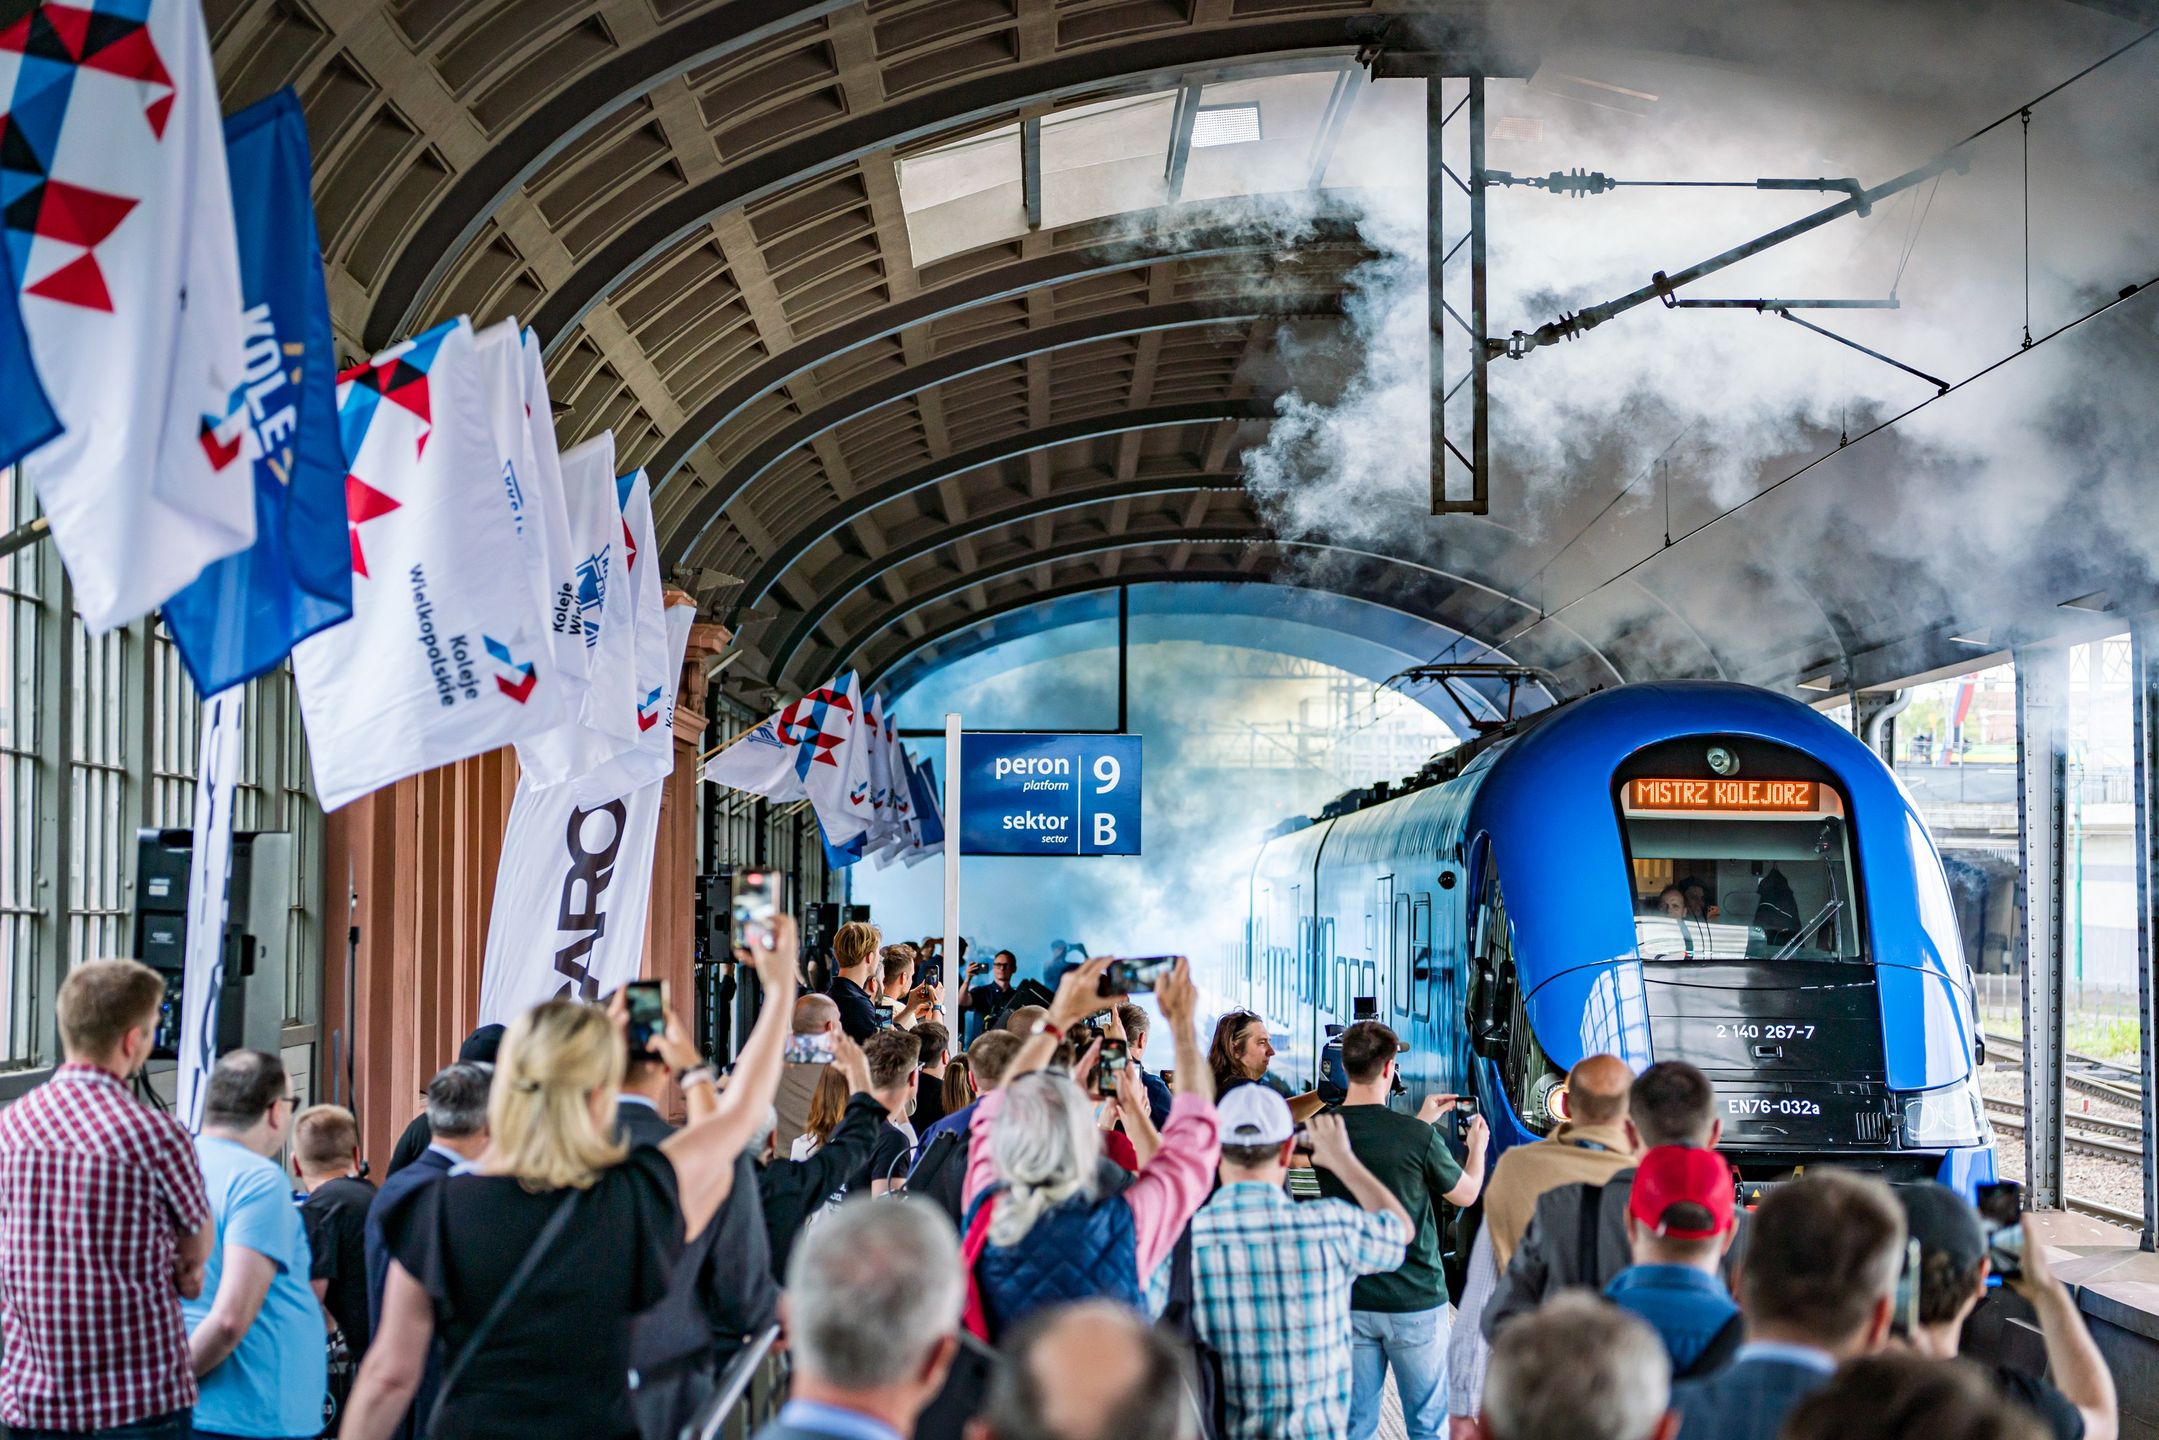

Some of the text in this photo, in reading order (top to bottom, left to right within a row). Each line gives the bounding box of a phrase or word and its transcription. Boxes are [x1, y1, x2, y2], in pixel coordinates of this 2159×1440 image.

[552, 582, 574, 633] Koleje
[408, 563, 456, 707] Wielkopolskie
[450, 634, 480, 700] Koleje
[995, 757, 1070, 780] peron
[1093, 755, 1121, 795] 9
[1022, 780, 1069, 793] platform
[1638, 781, 1809, 805] MISTRZ KOLEJORZ
[1003, 810, 1069, 830] sektor
[1093, 813, 1118, 846] B
[1041, 834, 1069, 844] sector
[551, 797, 627, 1001] ARO
[1715, 1024, 1816, 1040] 2 140 267-7
[1728, 1099, 1821, 1115] EN76-032a
